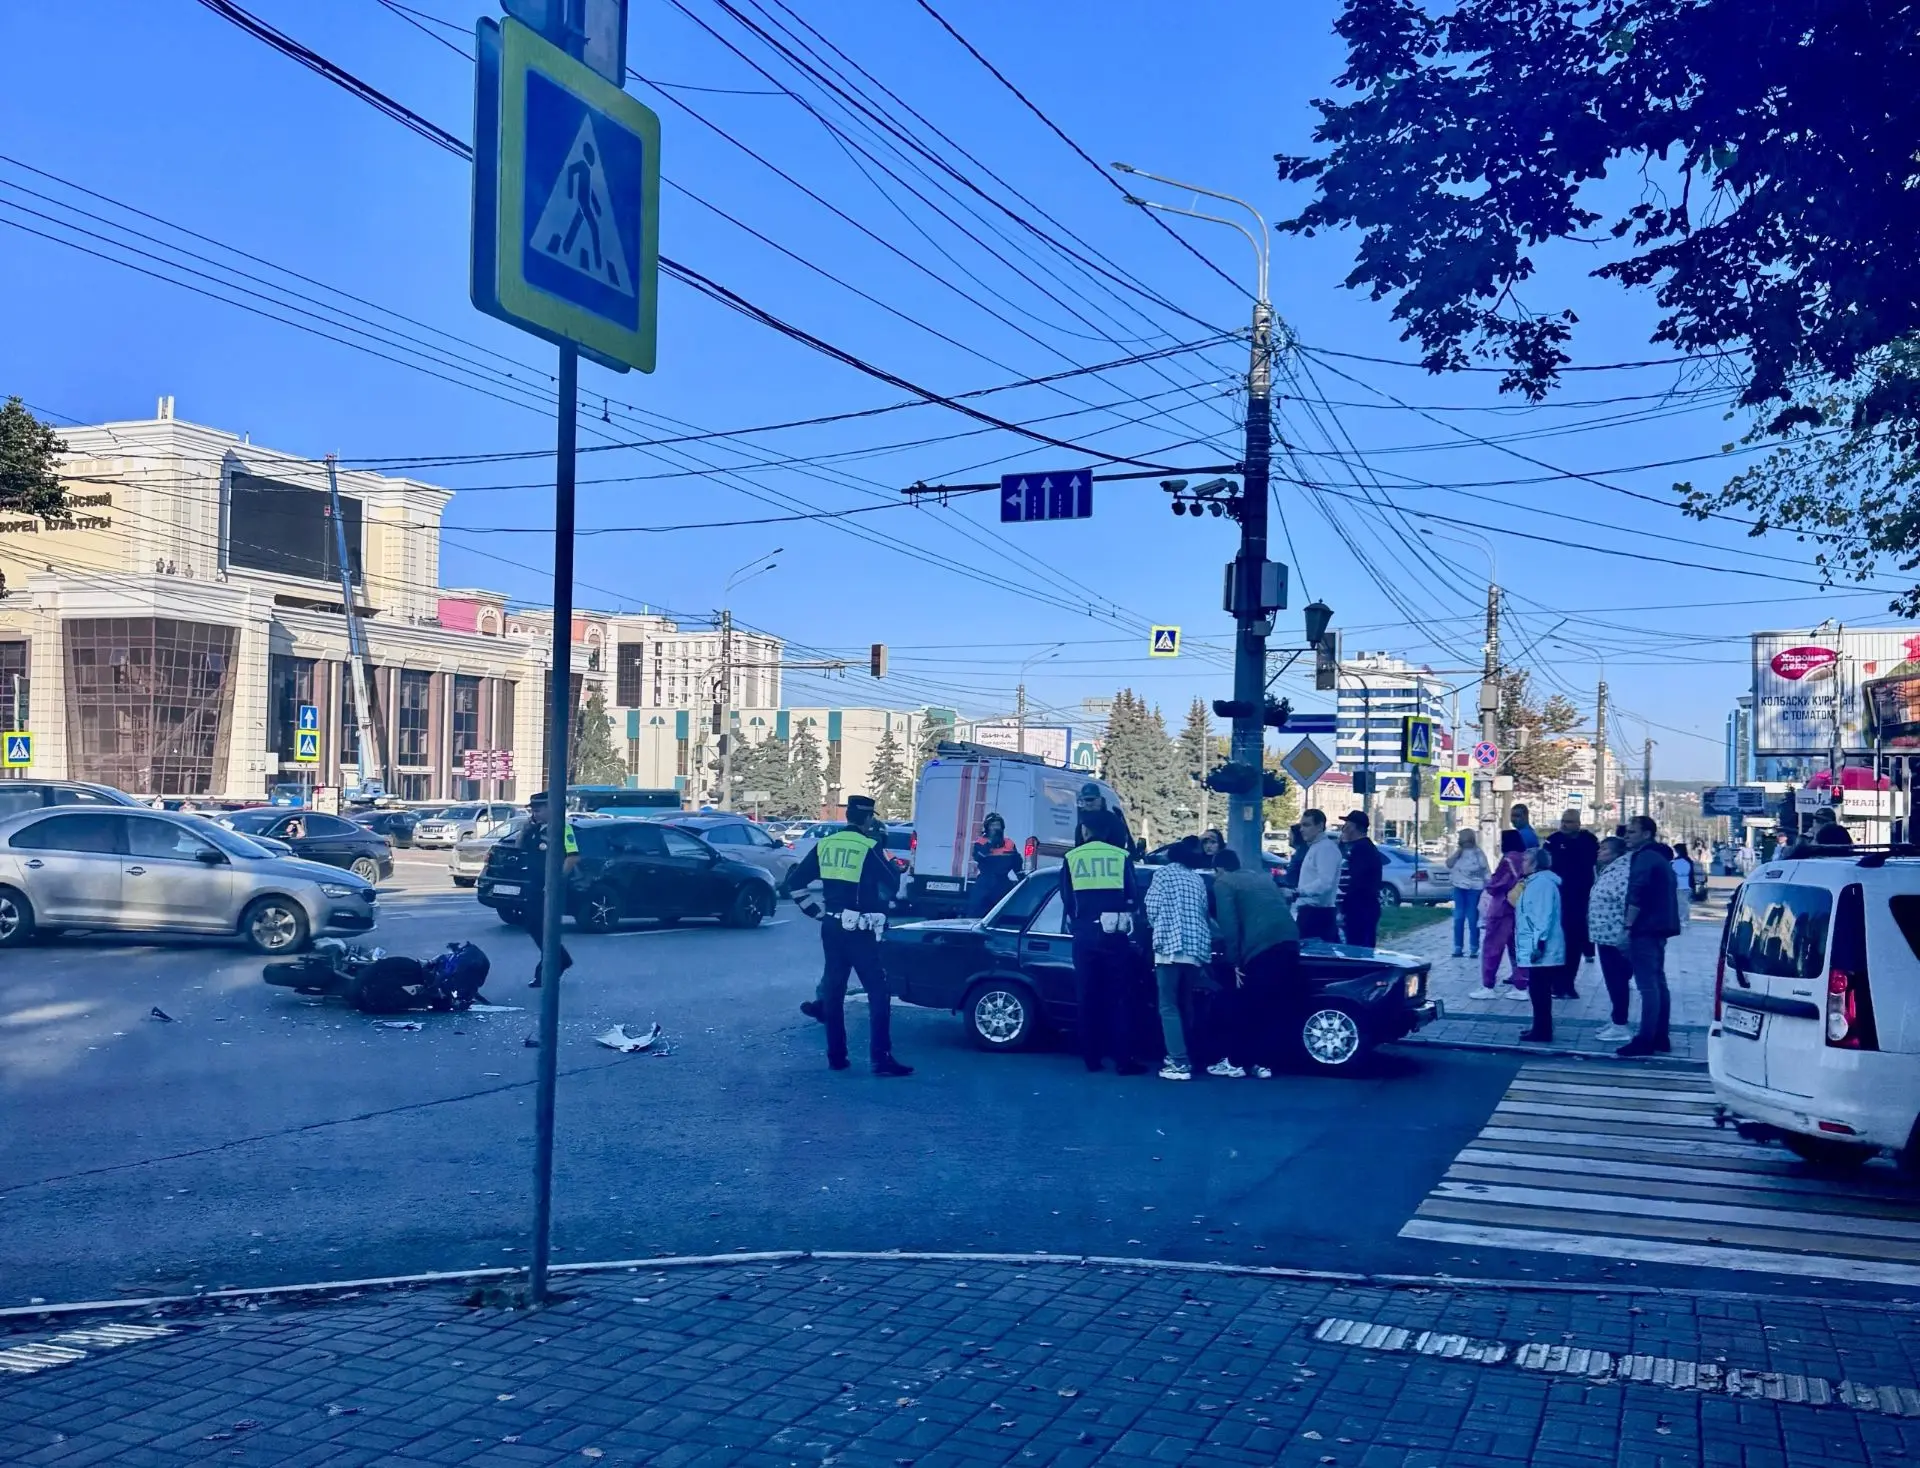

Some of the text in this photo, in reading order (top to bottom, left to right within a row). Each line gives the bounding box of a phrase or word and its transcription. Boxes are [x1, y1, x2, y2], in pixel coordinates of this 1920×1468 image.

[1761, 696, 1809, 706] КОЛБАСКИ
[1782, 711, 1836, 720] С ТОМАТОМ
[821, 848, 860, 869] ДПС
[1074, 858, 1119, 878] ДПС
